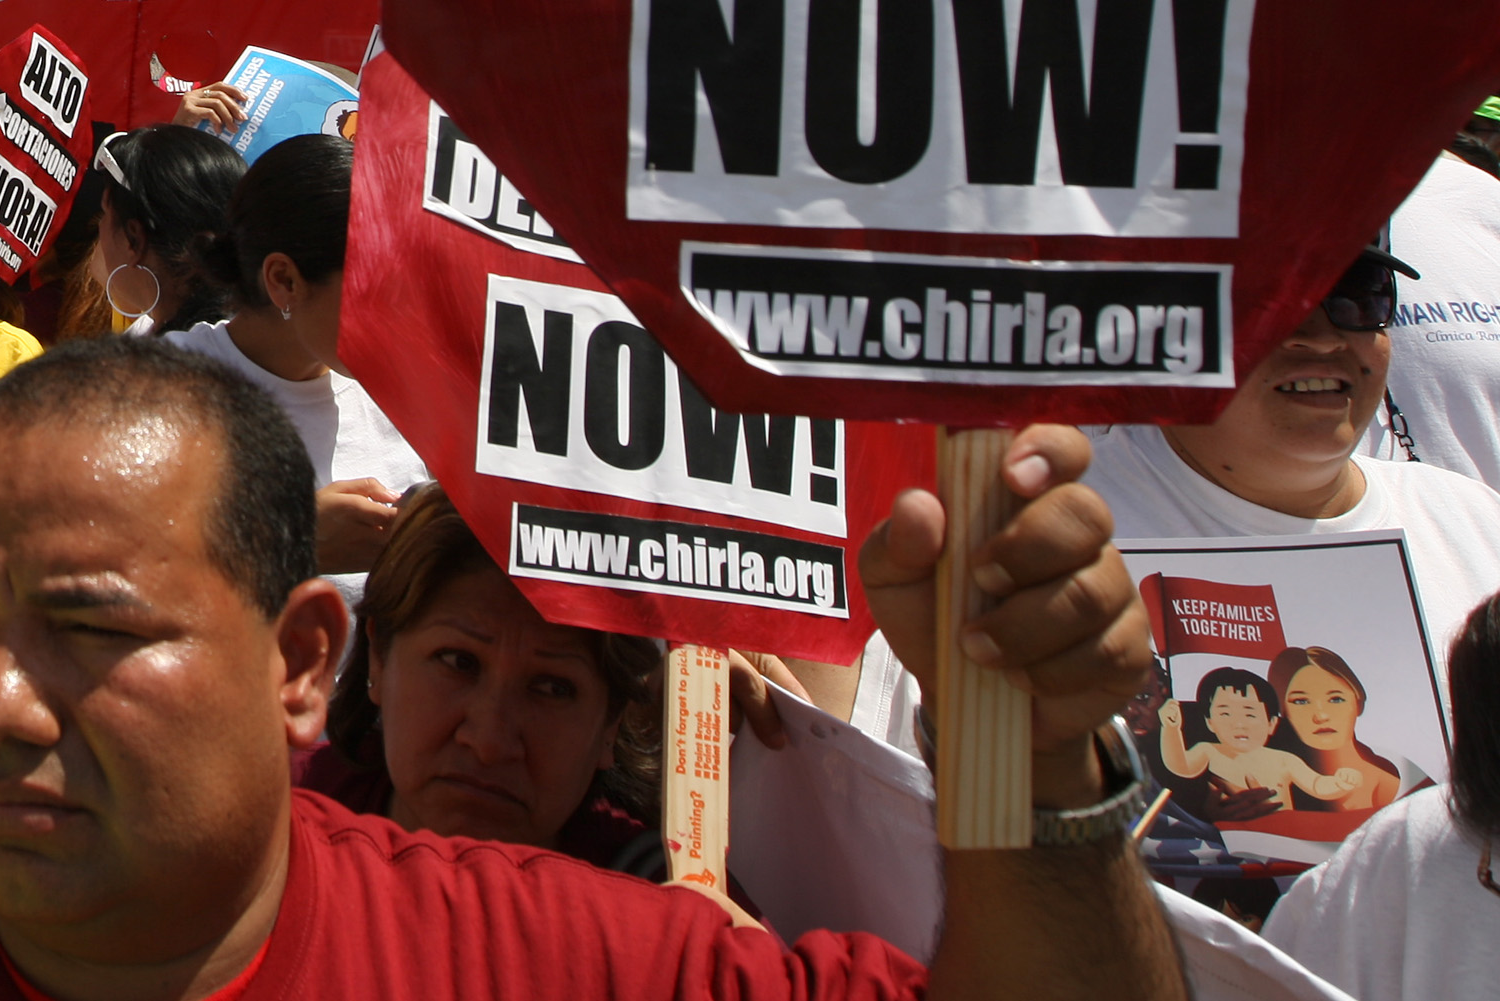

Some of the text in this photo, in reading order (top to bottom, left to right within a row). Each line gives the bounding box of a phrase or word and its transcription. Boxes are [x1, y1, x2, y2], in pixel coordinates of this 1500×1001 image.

[24, 43, 82, 124] ALTO
[235, 79, 285, 152] DEPORTATIONS
[694, 287, 1203, 374] www.chirla.org
[519, 522, 834, 608] www.chirla.org
[1172, 599, 1275, 623] KEEP FAMILIES
[1180, 619, 1261, 642] TOGETHER!
[679, 679, 687, 692] to
[676, 693, 690, 736] forget
[676, 739, 686, 775] Don't
[695, 742, 703, 768] Paint
[704, 744, 712, 770] Paint
[712, 745, 720, 771] Paint
[689, 790, 705, 859] Painting?
